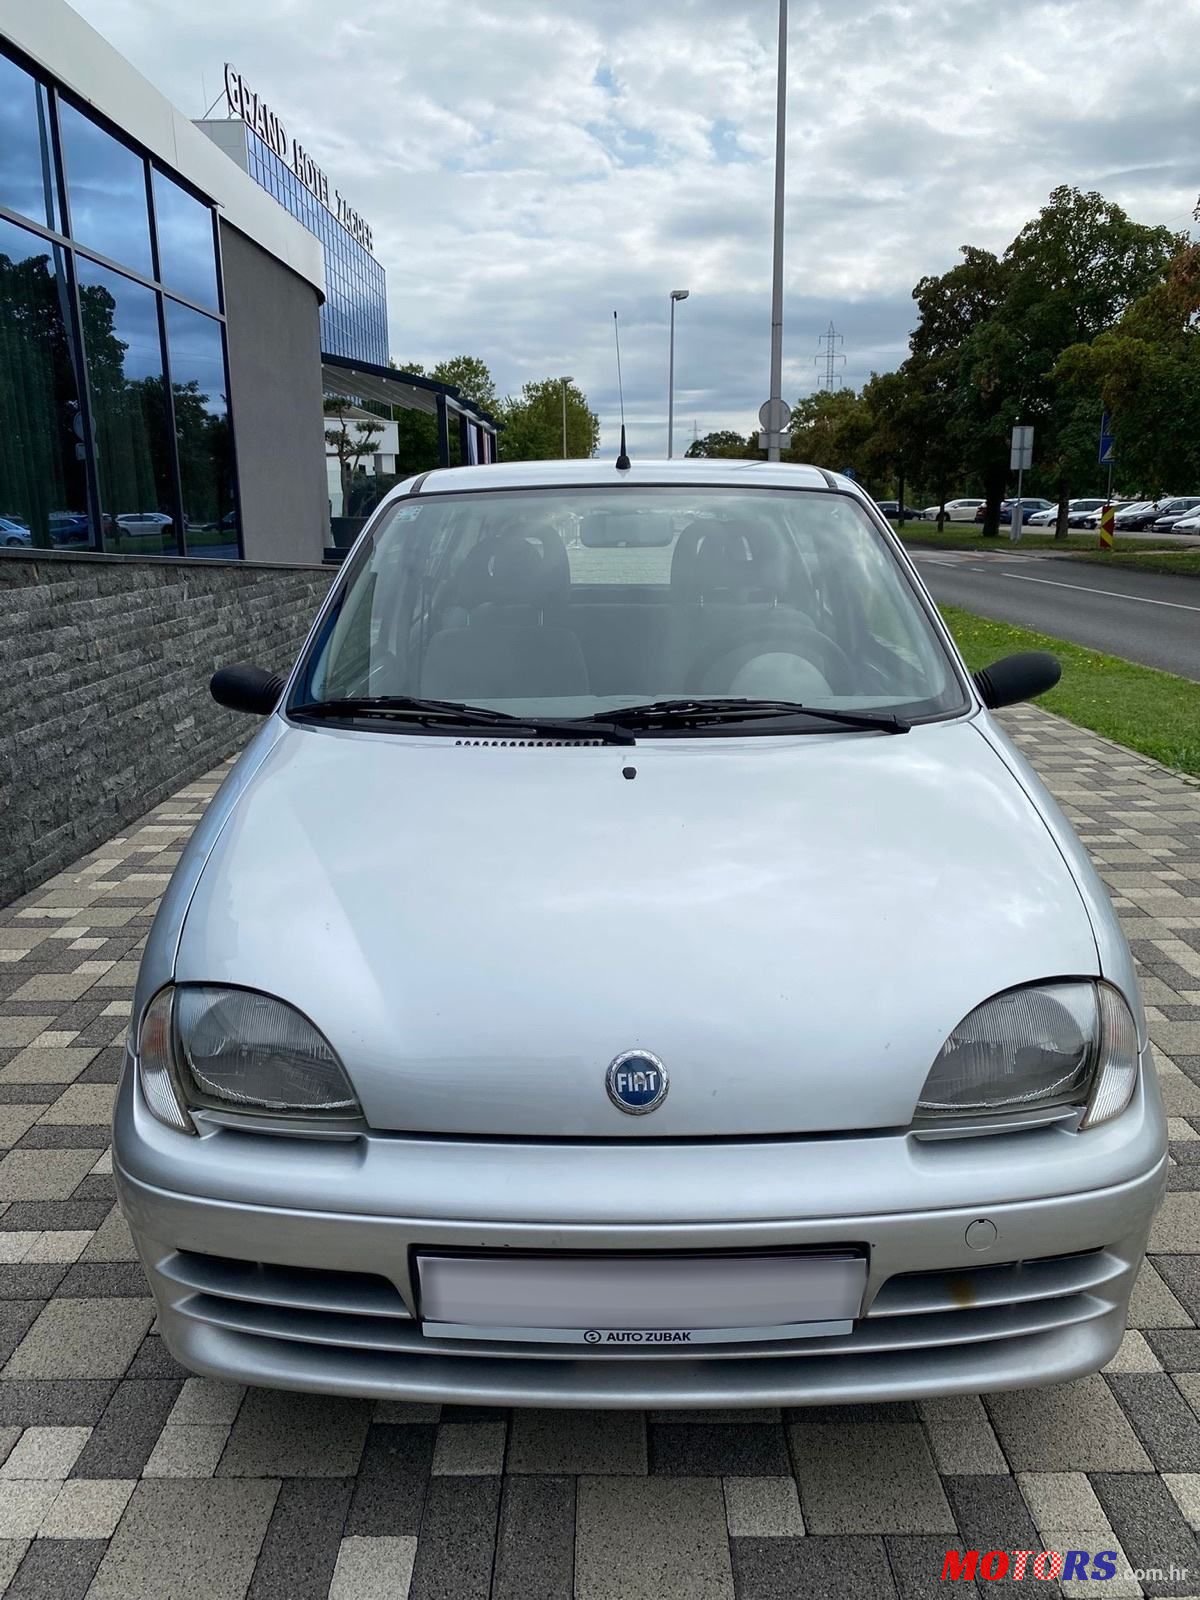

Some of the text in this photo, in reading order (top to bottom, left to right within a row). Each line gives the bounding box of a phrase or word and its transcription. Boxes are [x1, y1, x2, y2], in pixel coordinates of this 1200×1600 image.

[224, 63, 288, 156] GRAND
[617, 1070, 657, 1093] FIAT
[606, 1332, 691, 1342] AUTO ZUBAK
